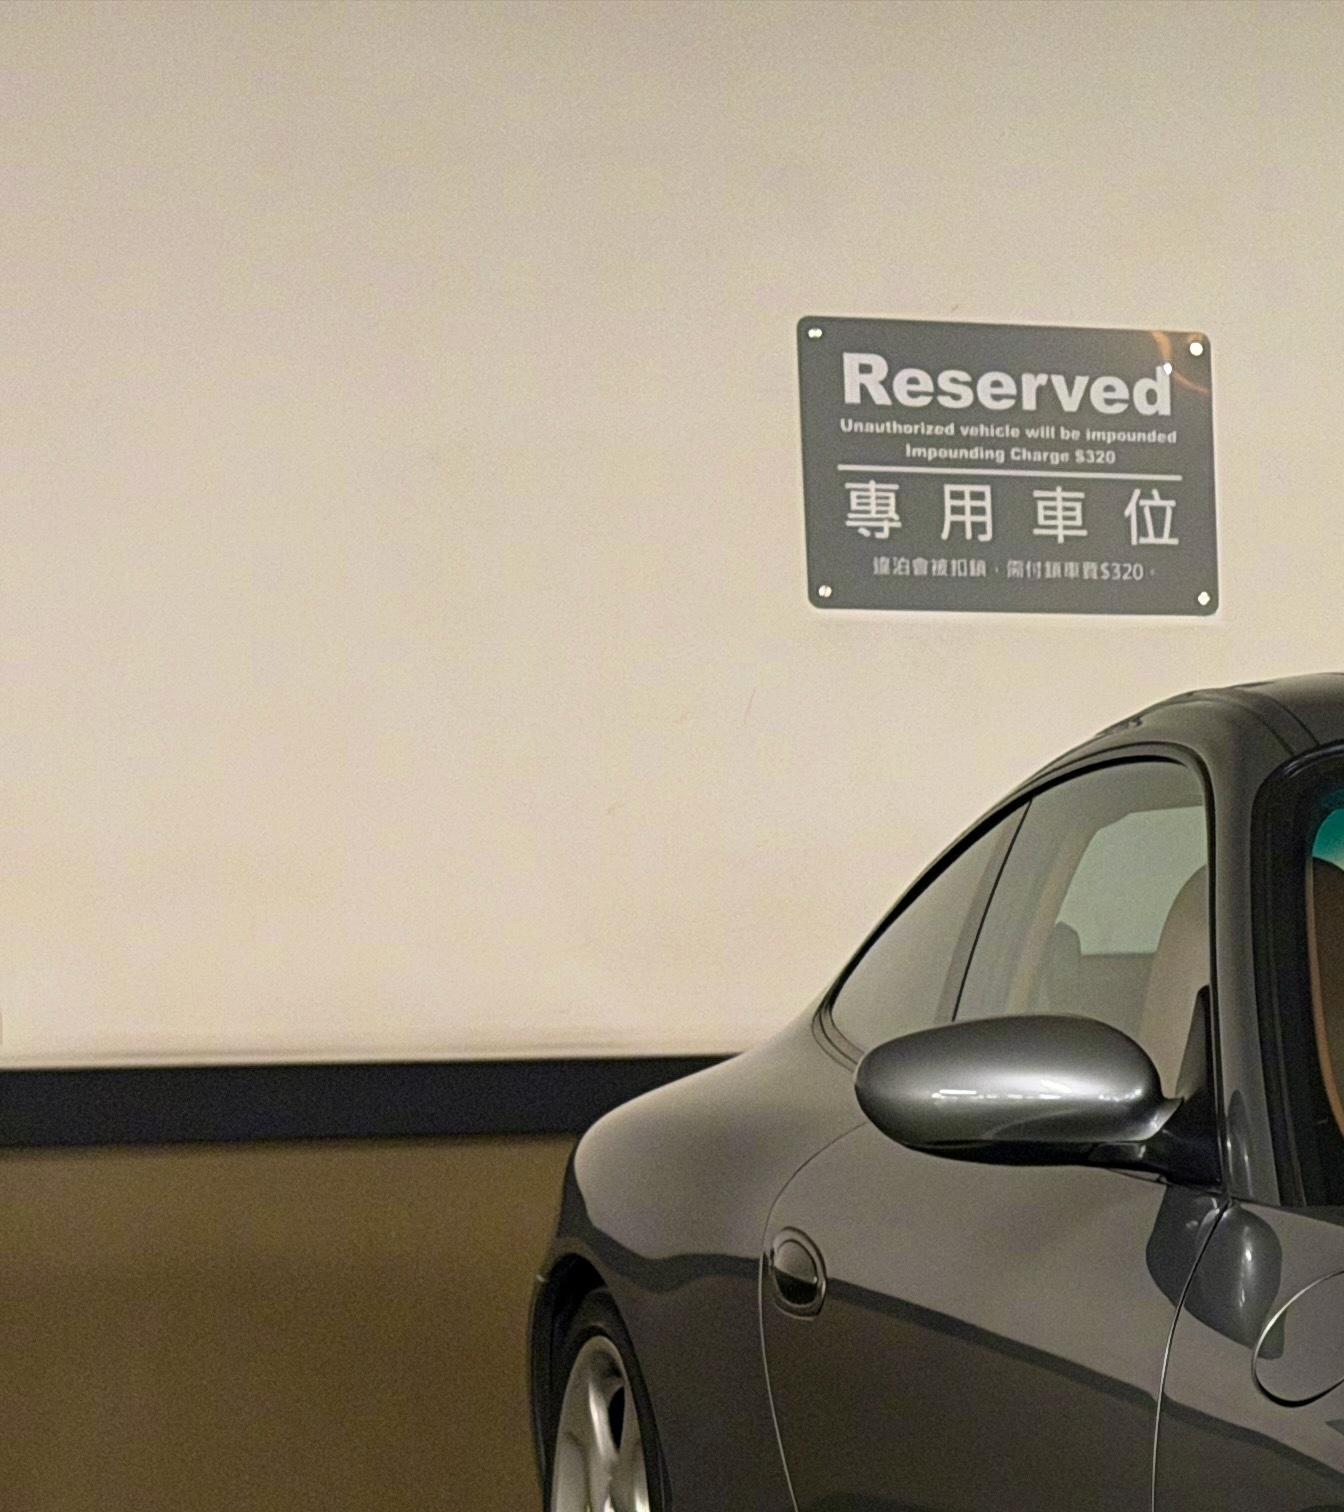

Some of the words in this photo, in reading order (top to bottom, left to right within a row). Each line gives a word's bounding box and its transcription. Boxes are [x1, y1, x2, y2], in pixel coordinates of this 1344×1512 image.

[842, 352, 1172, 416] Reserved
[840, 418, 955, 436] Unauthorized
[960, 423, 1020, 438] vehicle
[1025, 425, 1056, 439] will
[1060, 426, 1081, 440] be
[1086, 428, 1177, 444] impounded
[905, 443, 1005, 463] Impounding
[1010, 447, 1070, 465] Charge
[1075, 449, 1116, 464] $320
[844, 479, 1179, 546] 專用車位
